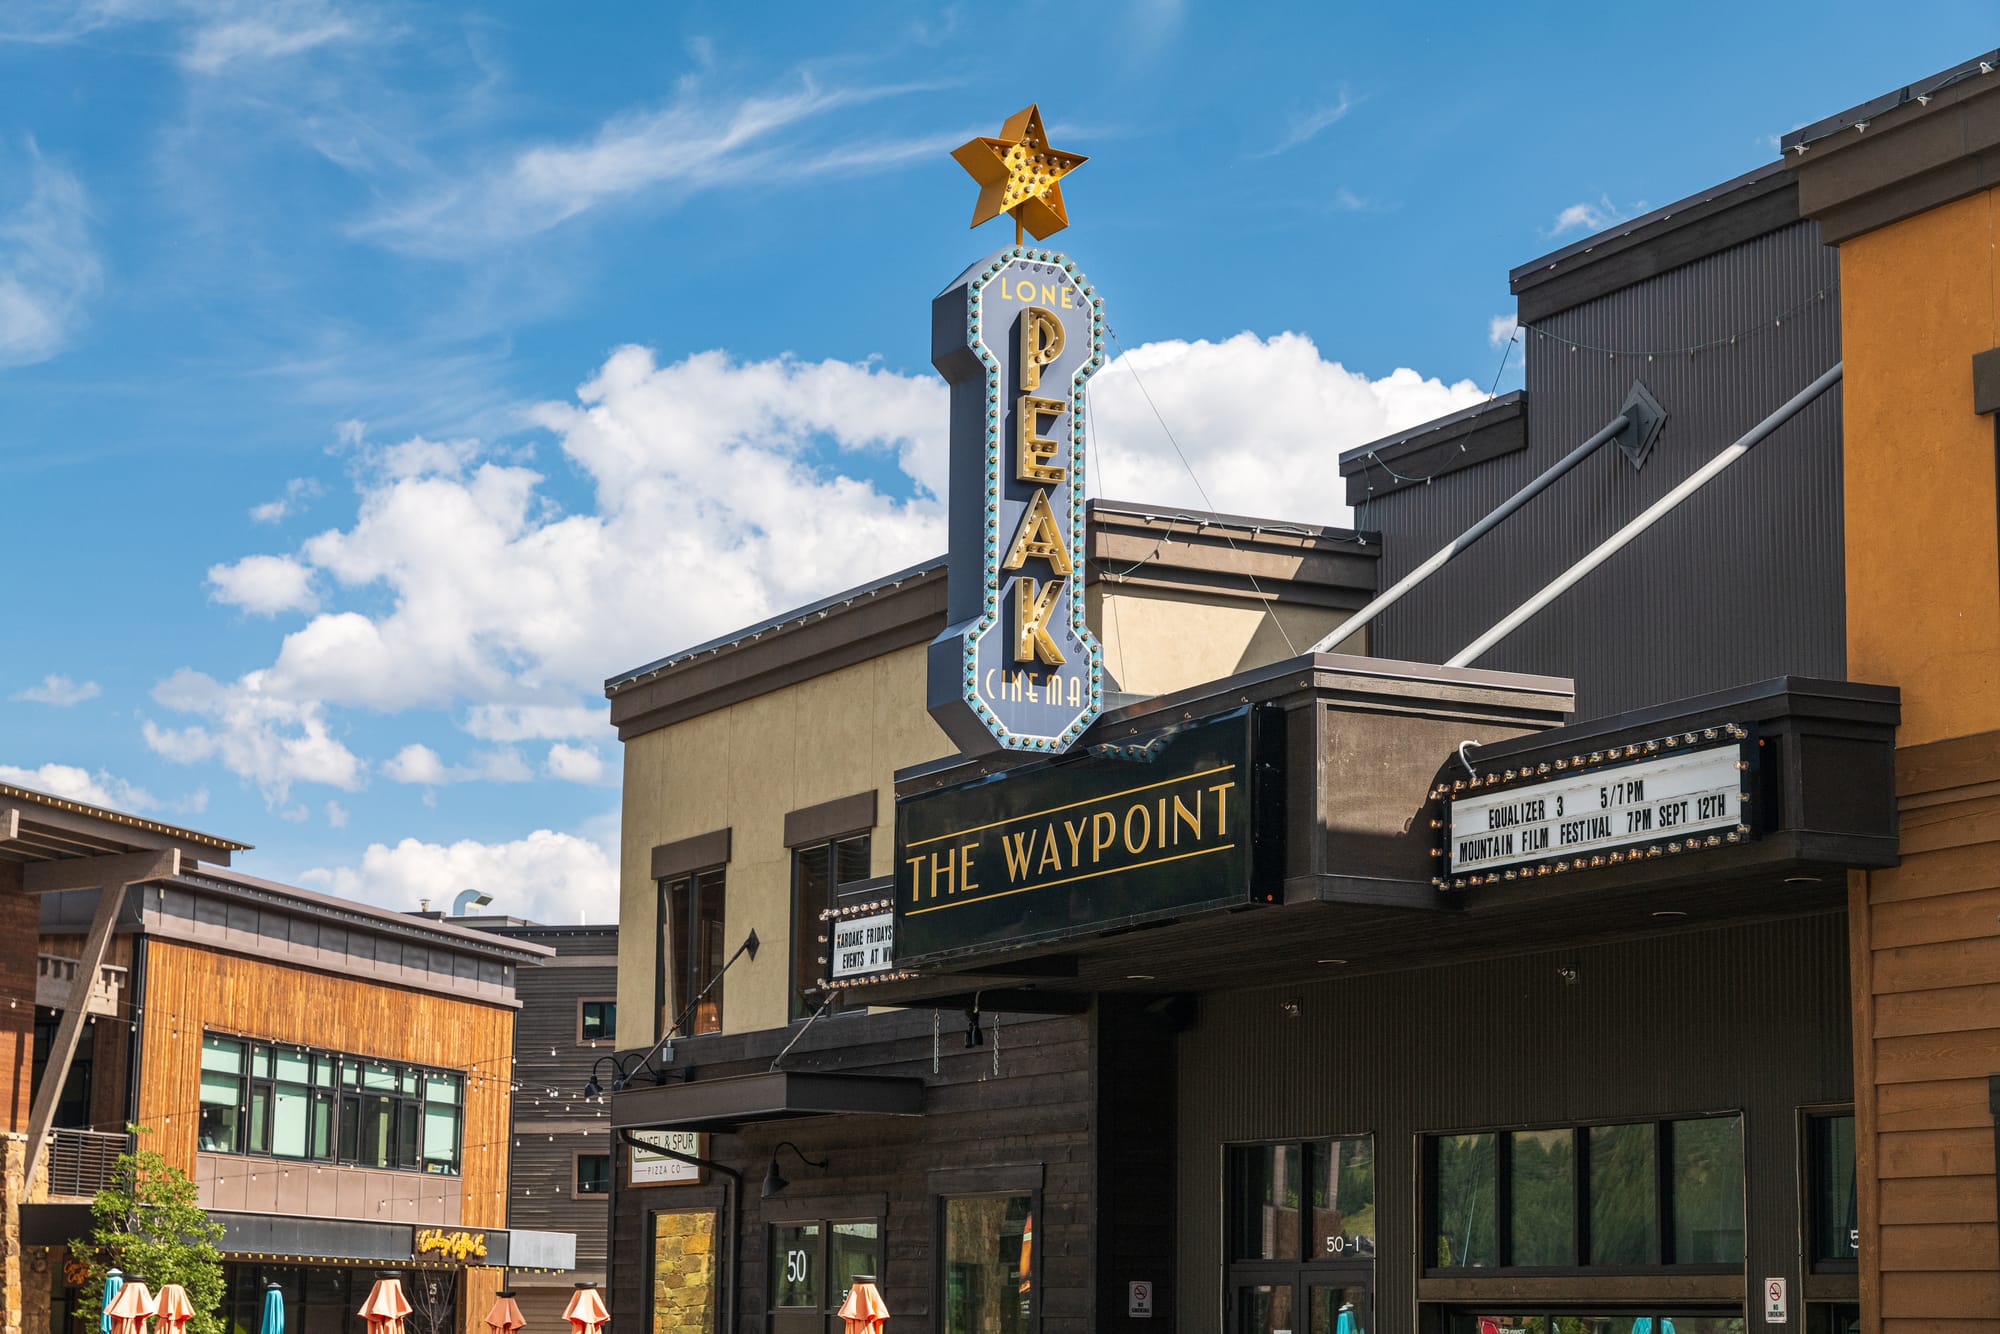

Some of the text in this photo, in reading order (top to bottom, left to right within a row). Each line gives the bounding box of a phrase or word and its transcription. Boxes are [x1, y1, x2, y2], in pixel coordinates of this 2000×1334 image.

[1001, 277, 1073, 309] LONE
[1003, 306, 1073, 666] PEAK
[985, 668, 1081, 708] CINEMA
[1459, 794, 1726, 863] MOUNTAIN FILM FESTIVAL 7PM SEPT 12TH
[1488, 799, 1545, 830] EQUALIZER
[1556, 796, 1564, 817] 3
[906, 782, 1236, 902] THE WAYPOINT
[866, 925, 893, 945] FRIDAYS
[842, 951, 865, 969] EVENTS
[870, 949, 879, 965] AT
[672, 1133, 694, 1151] SPUR
[647, 1165, 667, 1175] PIZZA
[1326, 1235, 1360, 1253] 50-1
[787, 1249, 807, 1283] 50
